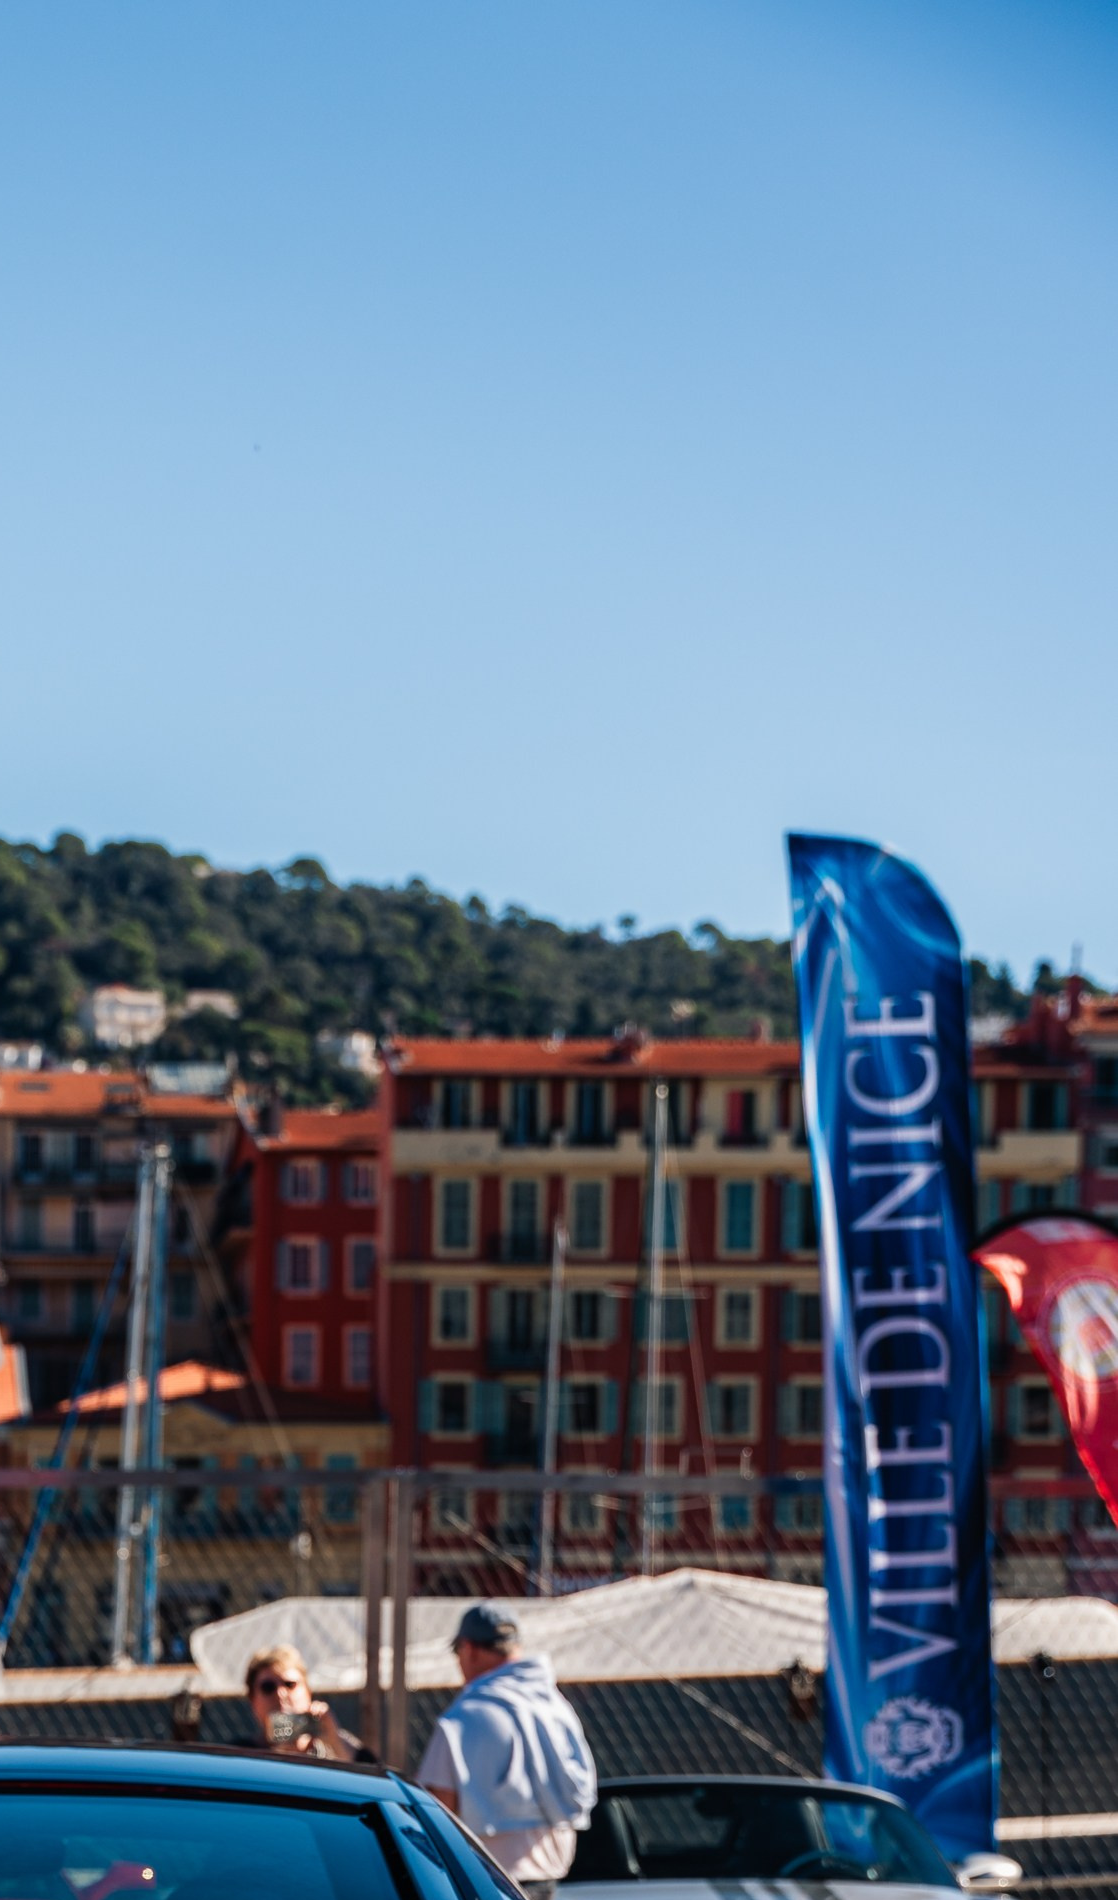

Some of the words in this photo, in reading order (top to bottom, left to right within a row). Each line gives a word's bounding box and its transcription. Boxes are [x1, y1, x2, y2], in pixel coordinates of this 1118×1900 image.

[842, 990, 942, 1232] NICE
[853, 1264, 951, 1397] DE
[866, 1420, 960, 1682] VILLE
